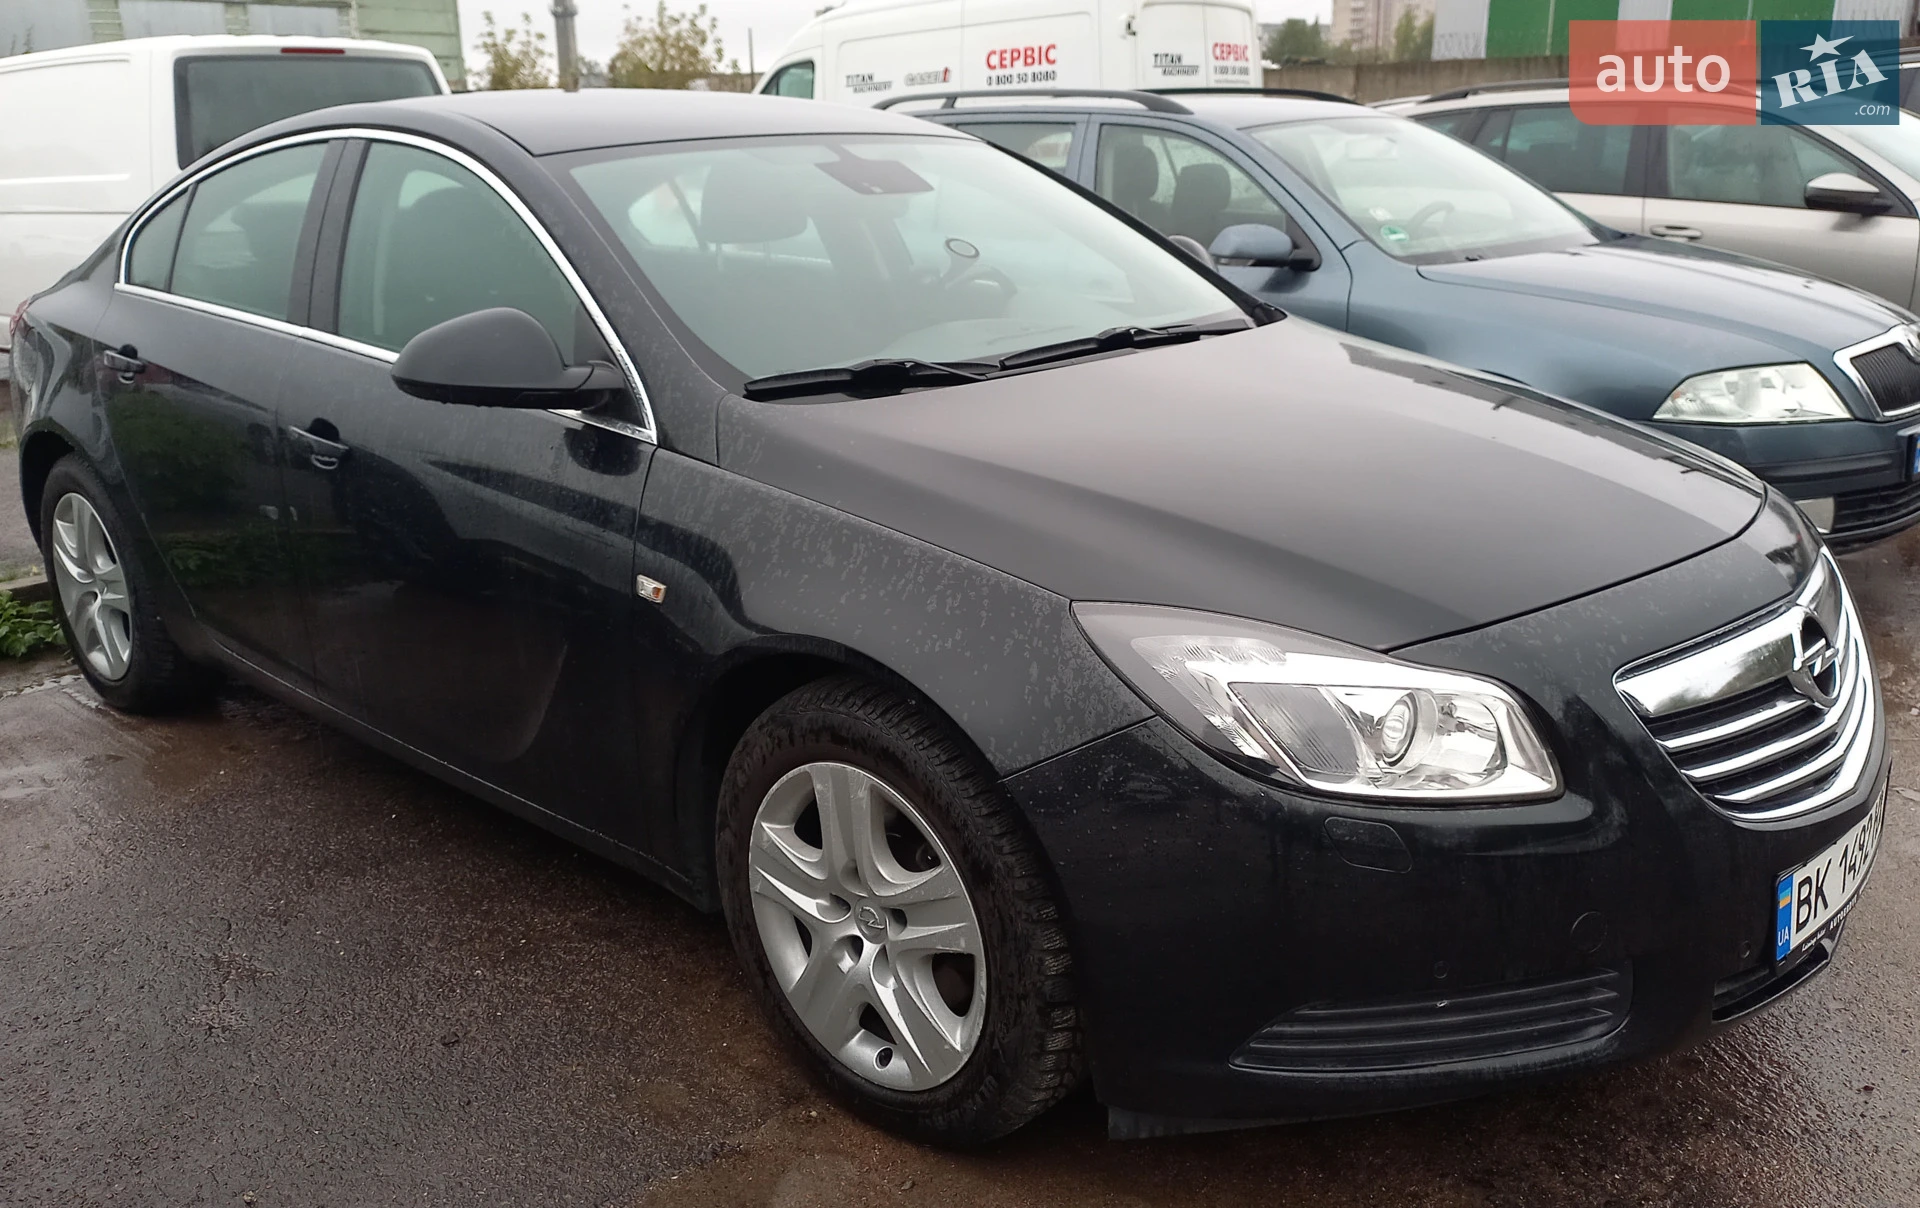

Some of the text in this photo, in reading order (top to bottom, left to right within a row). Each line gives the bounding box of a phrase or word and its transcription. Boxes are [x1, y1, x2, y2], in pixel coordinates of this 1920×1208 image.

[986, 44, 1056, 70] СЕРВІС
[1153, 53, 1182, 65] TITAN
[1795, 858, 1832, 935] BK
[1778, 926, 1790, 947] UA
